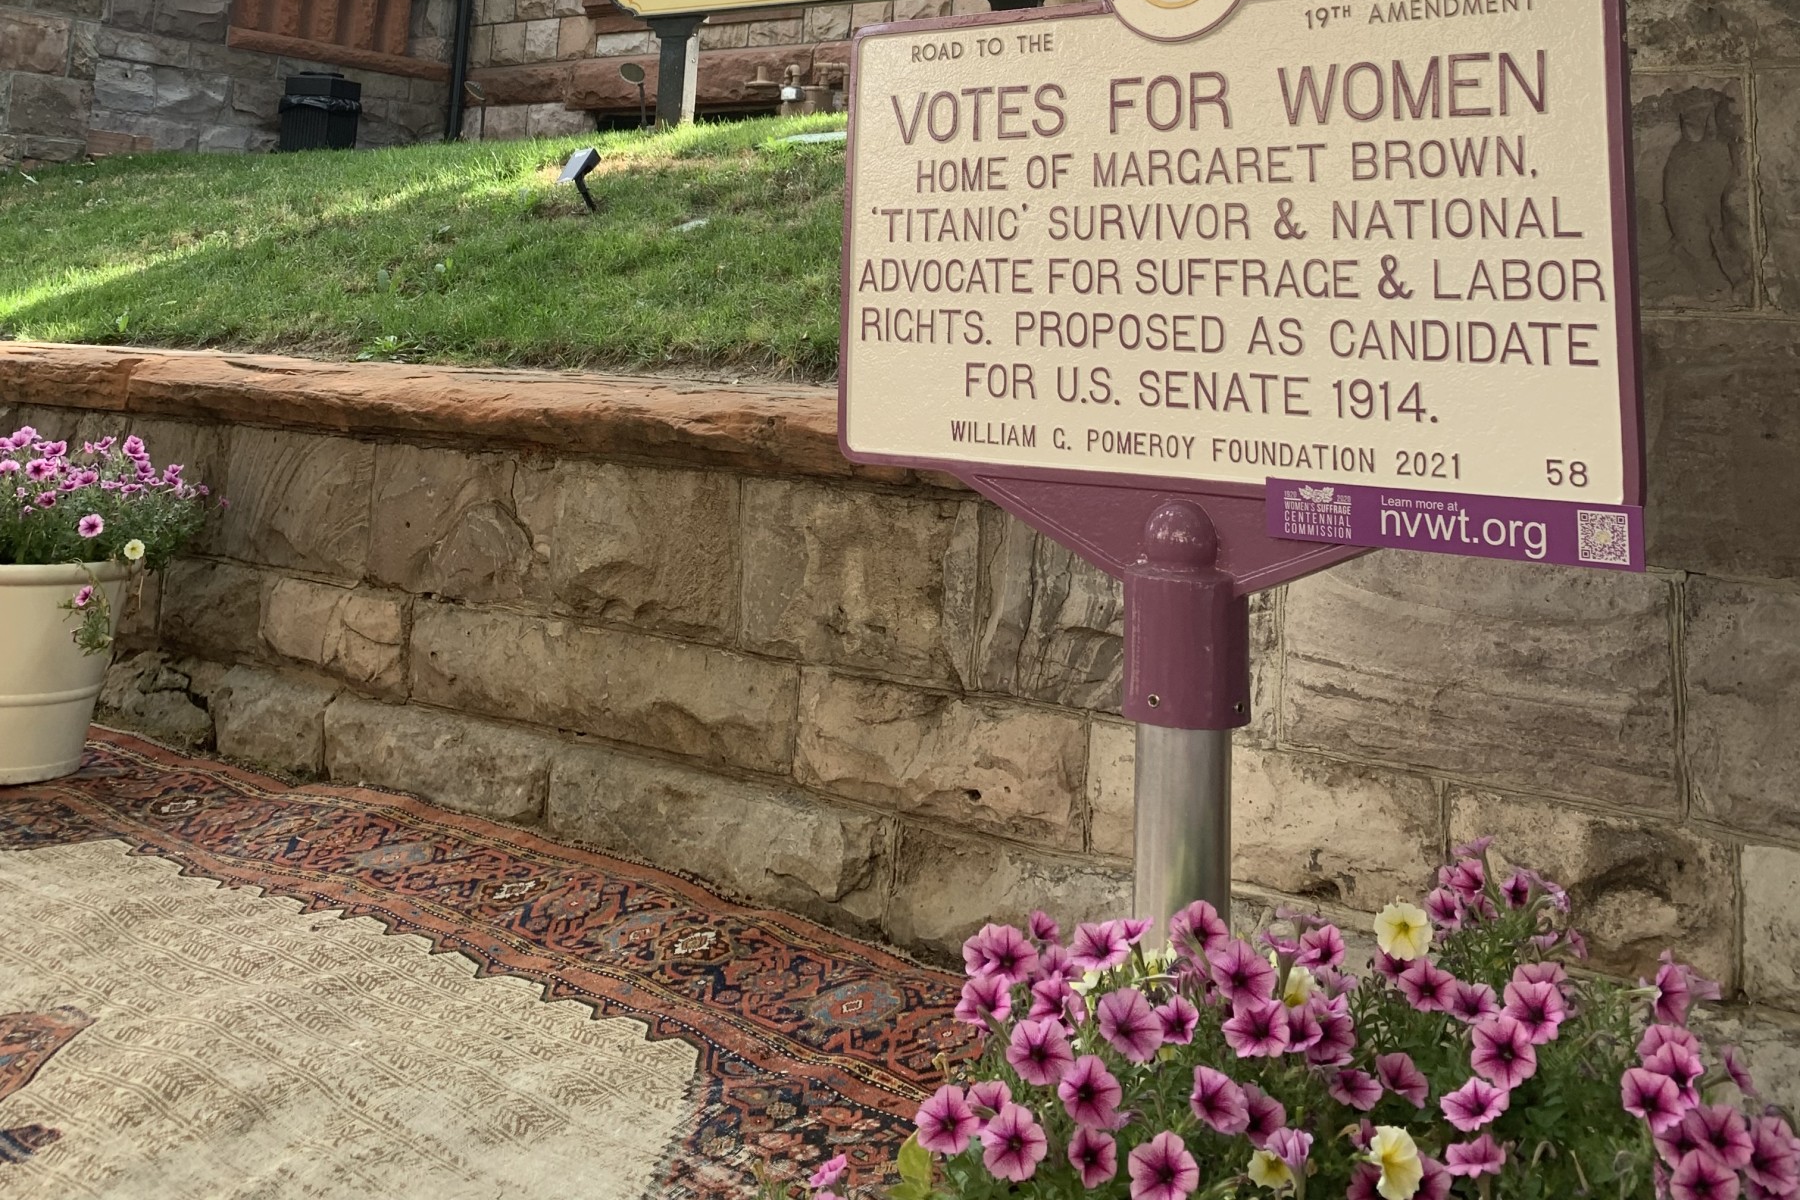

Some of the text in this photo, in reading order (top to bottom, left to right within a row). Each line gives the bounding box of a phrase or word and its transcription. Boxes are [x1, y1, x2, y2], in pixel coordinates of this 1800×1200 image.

[1304, 5, 1351, 29] 19TH
[911, 33, 1054, 62] ROAD TO THE
[890, 49, 1546, 145] VOTES FOR WOMEN
[916, 156, 1008, 193] HOME
[1026, 153, 1074, 190] OF
[1093, 142, 1326, 187] MARGARET
[1048, 202, 1250, 240] SURVIVOR
[1273, 197, 1307, 240] &
[1332, 196, 1584, 239] NATIONAL
[859, 254, 1606, 301] ADVOCATE FOR SUFFRAGE & LABOR
[861, 307, 1600, 367] RIGHTS. PROPOSED AS CANDIDATE
[965, 362, 1439, 423] FOR U.S. SENATE 1914.
[951, 420, 1462, 480] WILLIAM G. POMEROY FOUNDATION 2021
[1545, 458, 1588, 487] 58
[1284, 500, 1352, 516] WOMEN'S SUFFRAGE
[1284, 510, 1352, 528] CENTENNIAL
[1381, 495, 1459, 512] Learn more at
[1284, 521, 1352, 539] COMMISSION
[1380, 506, 1548, 559] nvwt.org
